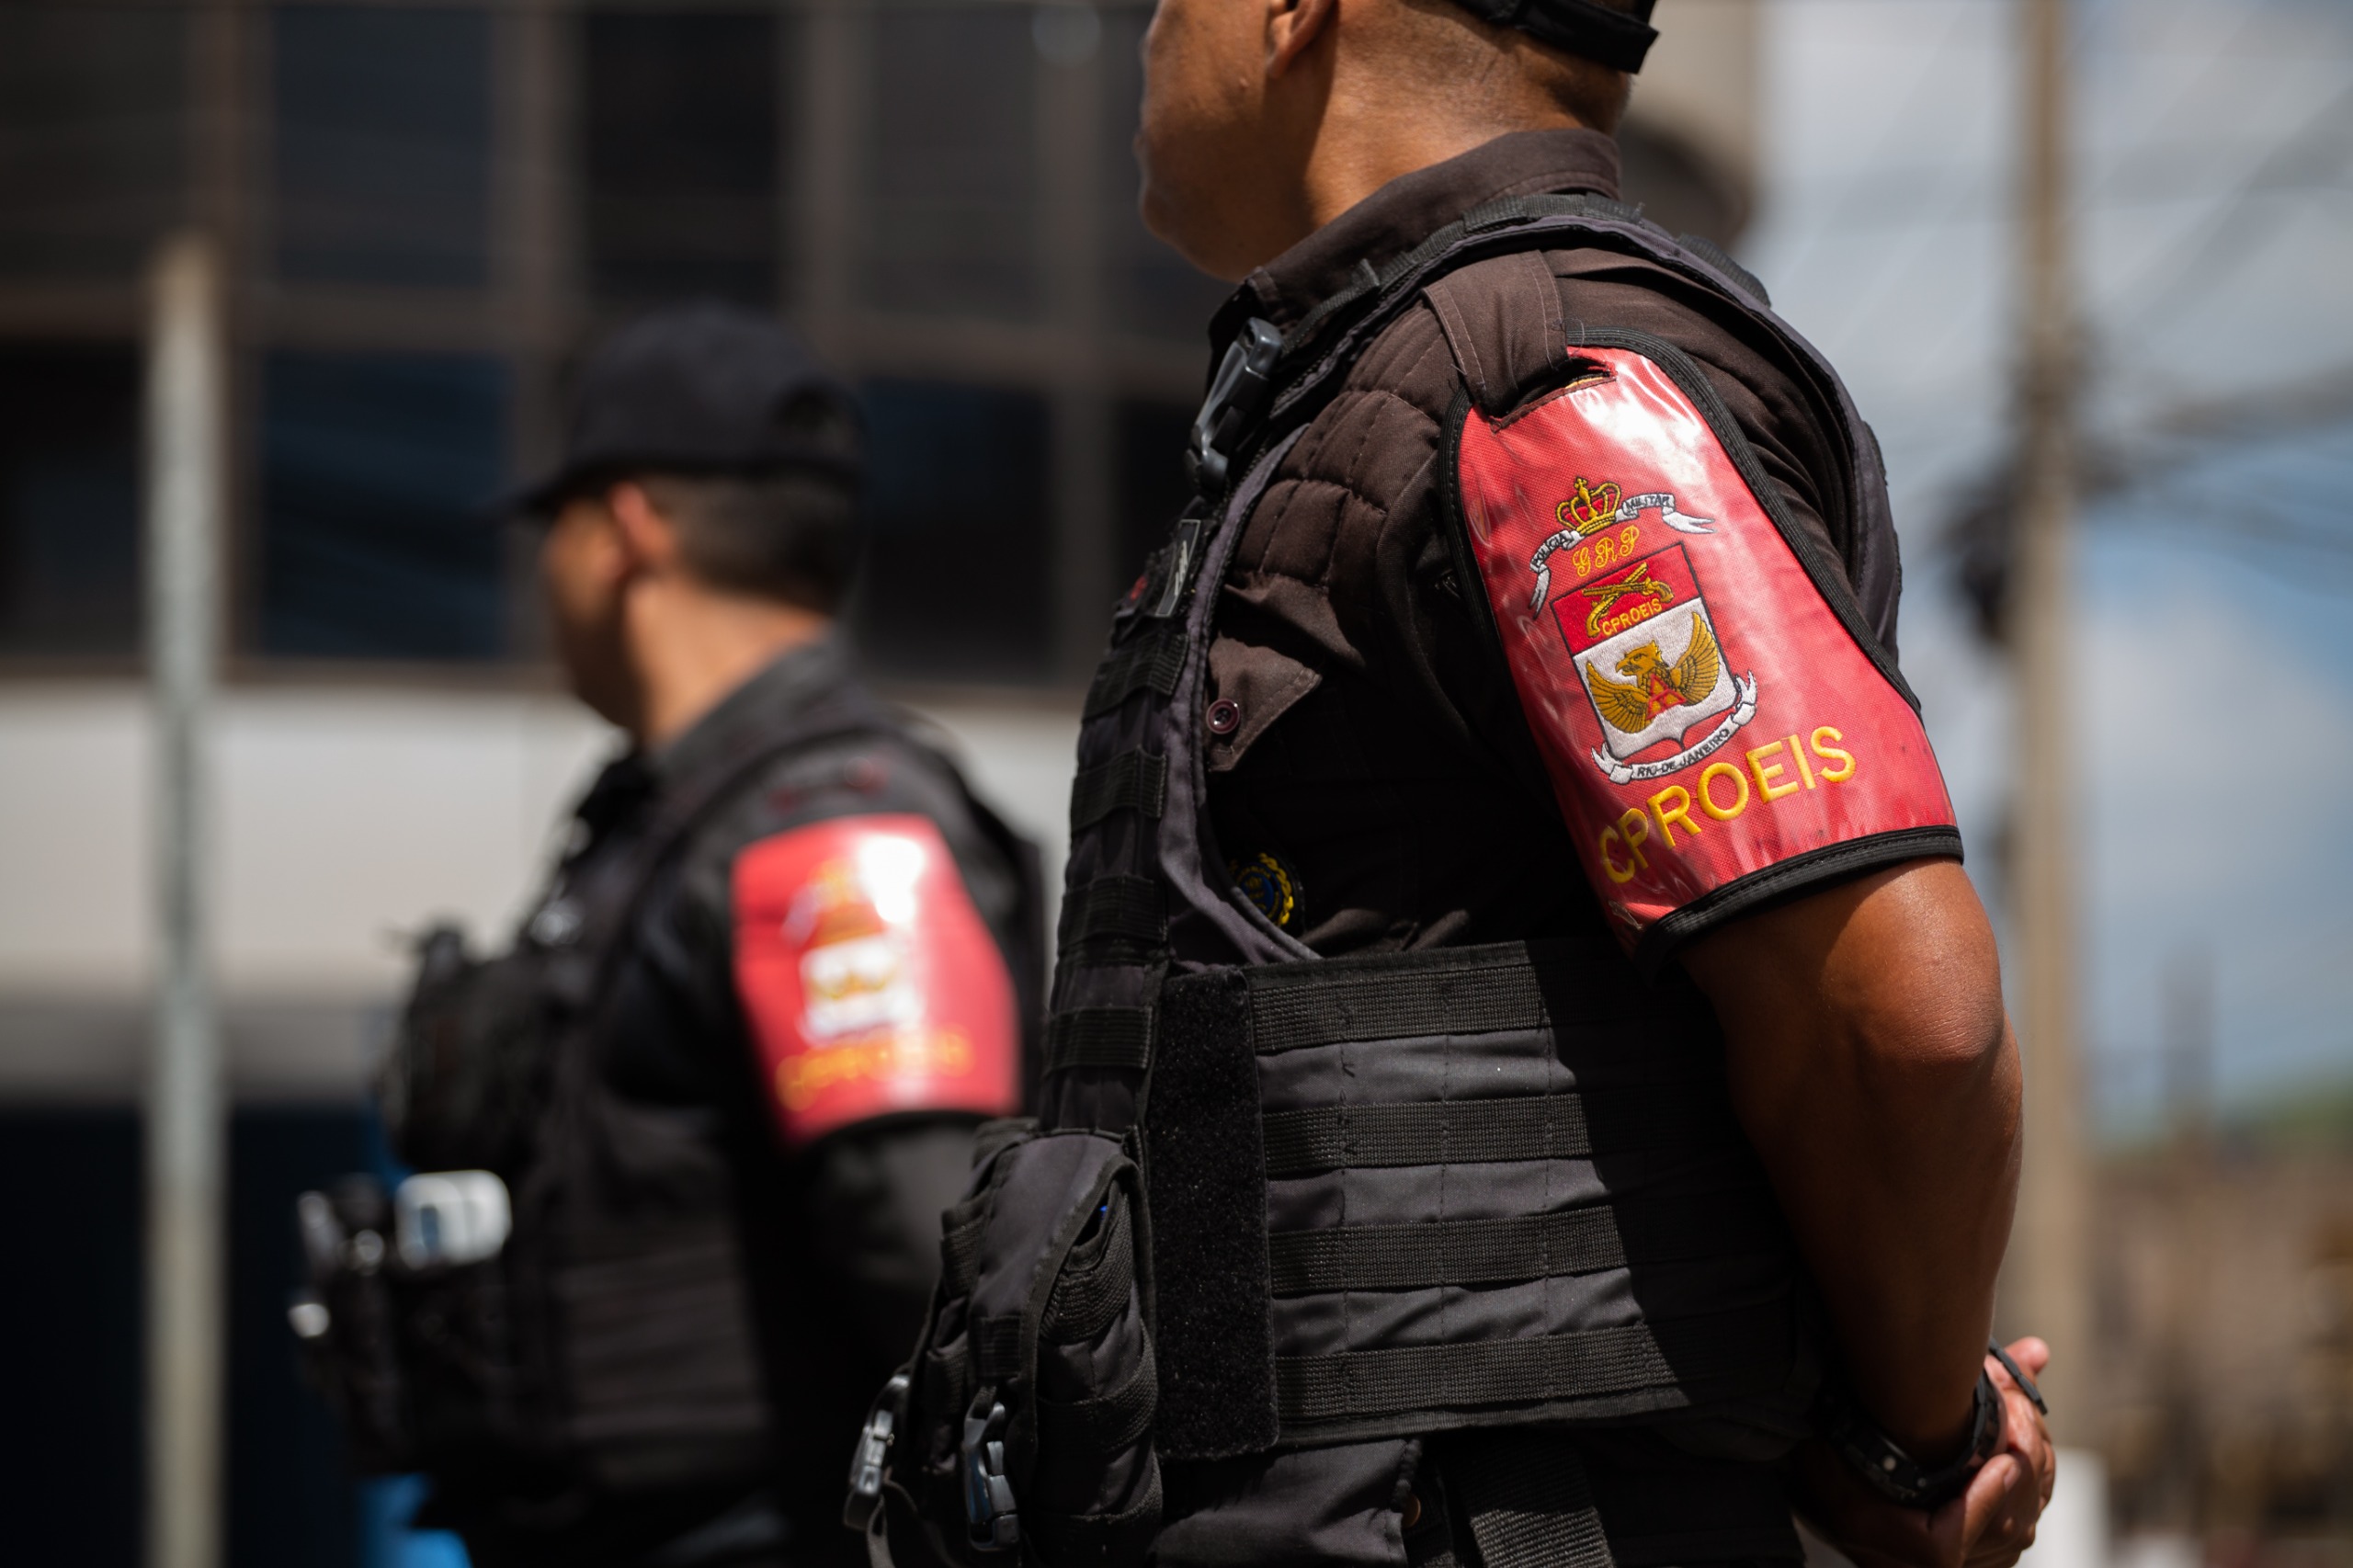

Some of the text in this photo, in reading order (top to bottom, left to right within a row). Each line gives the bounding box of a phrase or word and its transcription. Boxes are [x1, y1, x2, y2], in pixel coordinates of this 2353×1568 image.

[1626, 494, 1671, 511] MILITAR
[1601, 598, 1663, 636] CPROEIS
[1679, 728, 1730, 766] JANEIRO
[1598, 725, 1857, 884] CPROEIS
